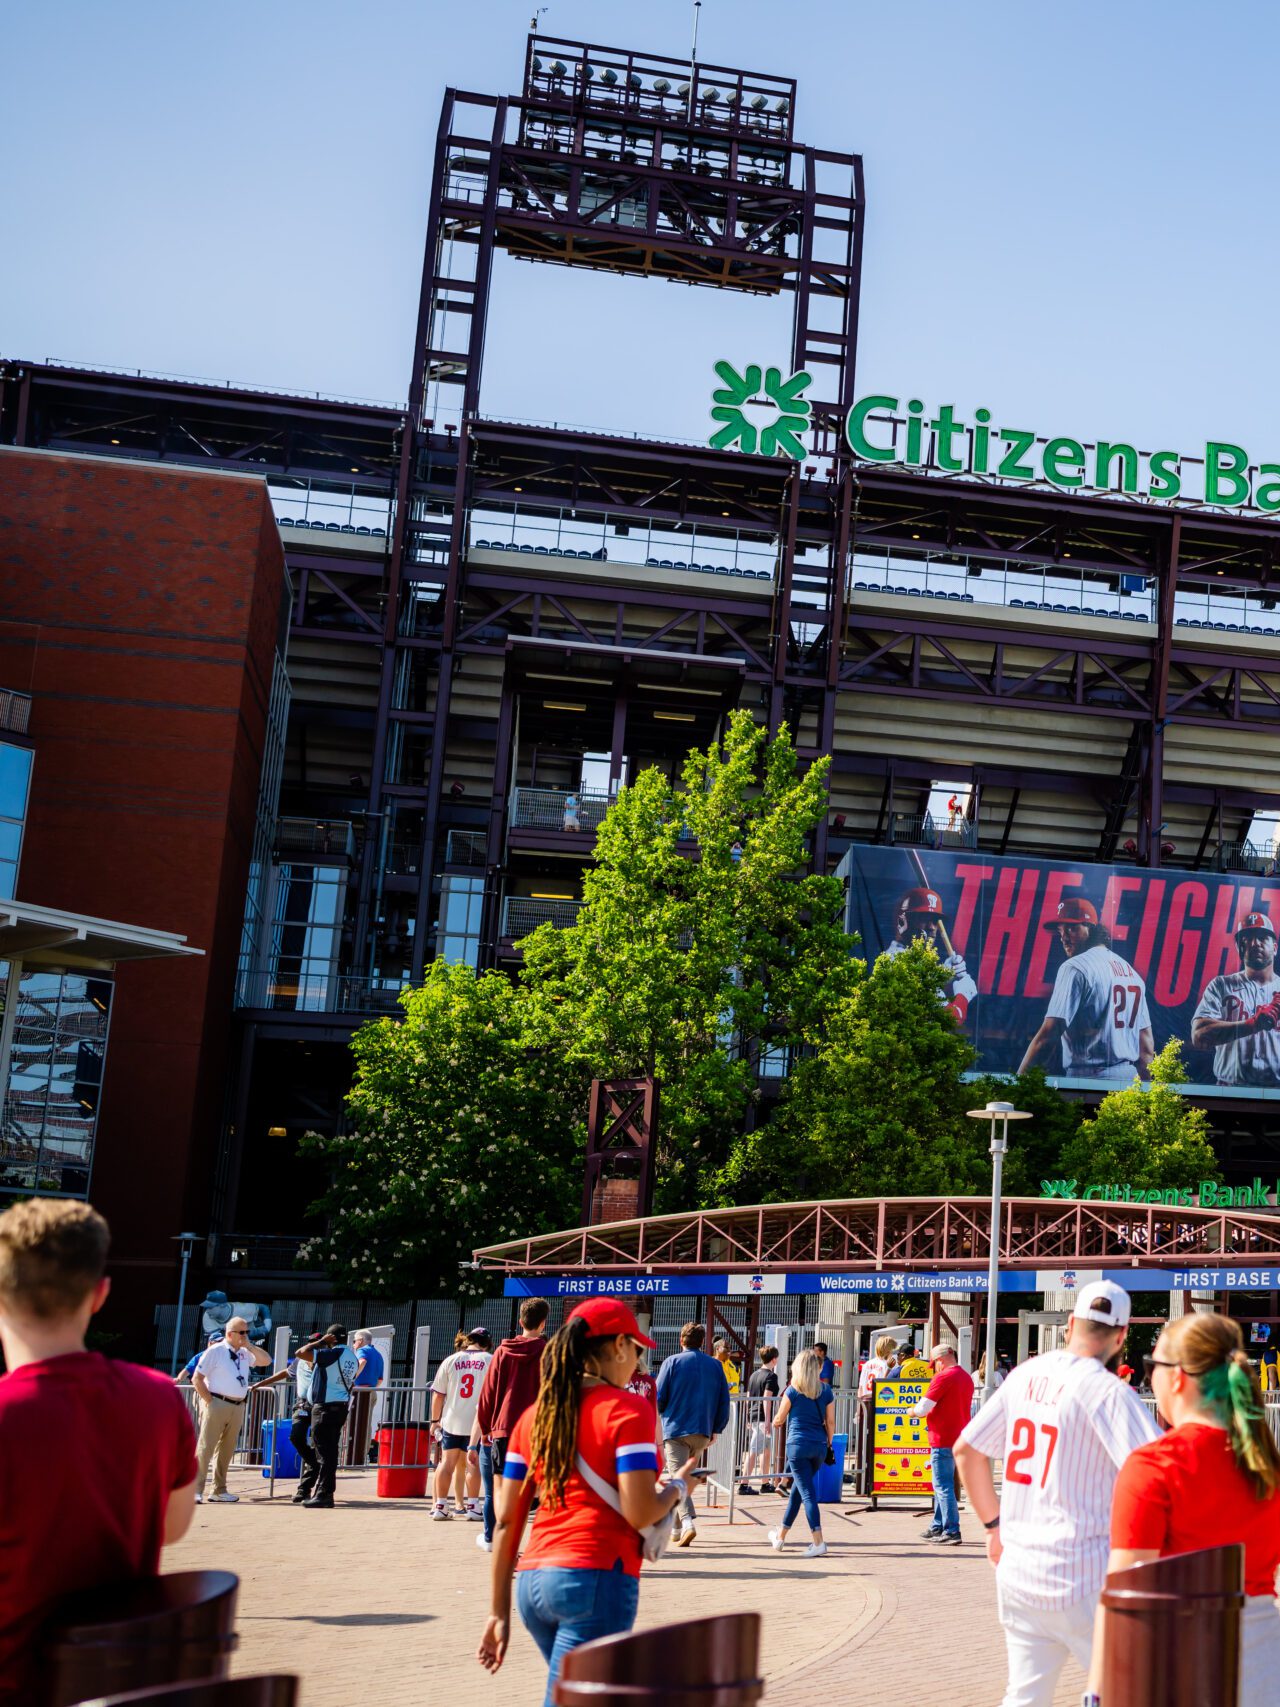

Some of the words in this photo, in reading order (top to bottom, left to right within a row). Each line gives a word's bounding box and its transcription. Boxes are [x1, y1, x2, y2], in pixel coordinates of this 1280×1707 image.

[846, 394, 1181, 500] Citizens
[951, 863, 1083, 998] THE
[1109, 960, 1135, 977] NOLA
[1112, 984, 1142, 1029] 27
[1083, 1183, 1193, 1207] Citizens
[1198, 1177, 1271, 1208] Bank
[558, 1280, 594, 1292] FIRST
[598, 1280, 632, 1292] BASE
[636, 1279, 670, 1291] GATE
[820, 1276, 873, 1289] Welcome
[876, 1277, 888, 1288] to
[907, 1276, 947, 1288] Citizens
[949, 1276, 973, 1287] Bank
[975, 1275, 990, 1287] Pa
[1173, 1272, 1220, 1286] FIRST
[1226, 1271, 1270, 1286] BASE
[454, 1360, 486, 1371] HARPER
[908, 1366, 926, 1377] CSC
[459, 1373, 475, 1399] 3
[899, 1385, 922, 1394] BAG
[1005, 1417, 1059, 1489] 27
